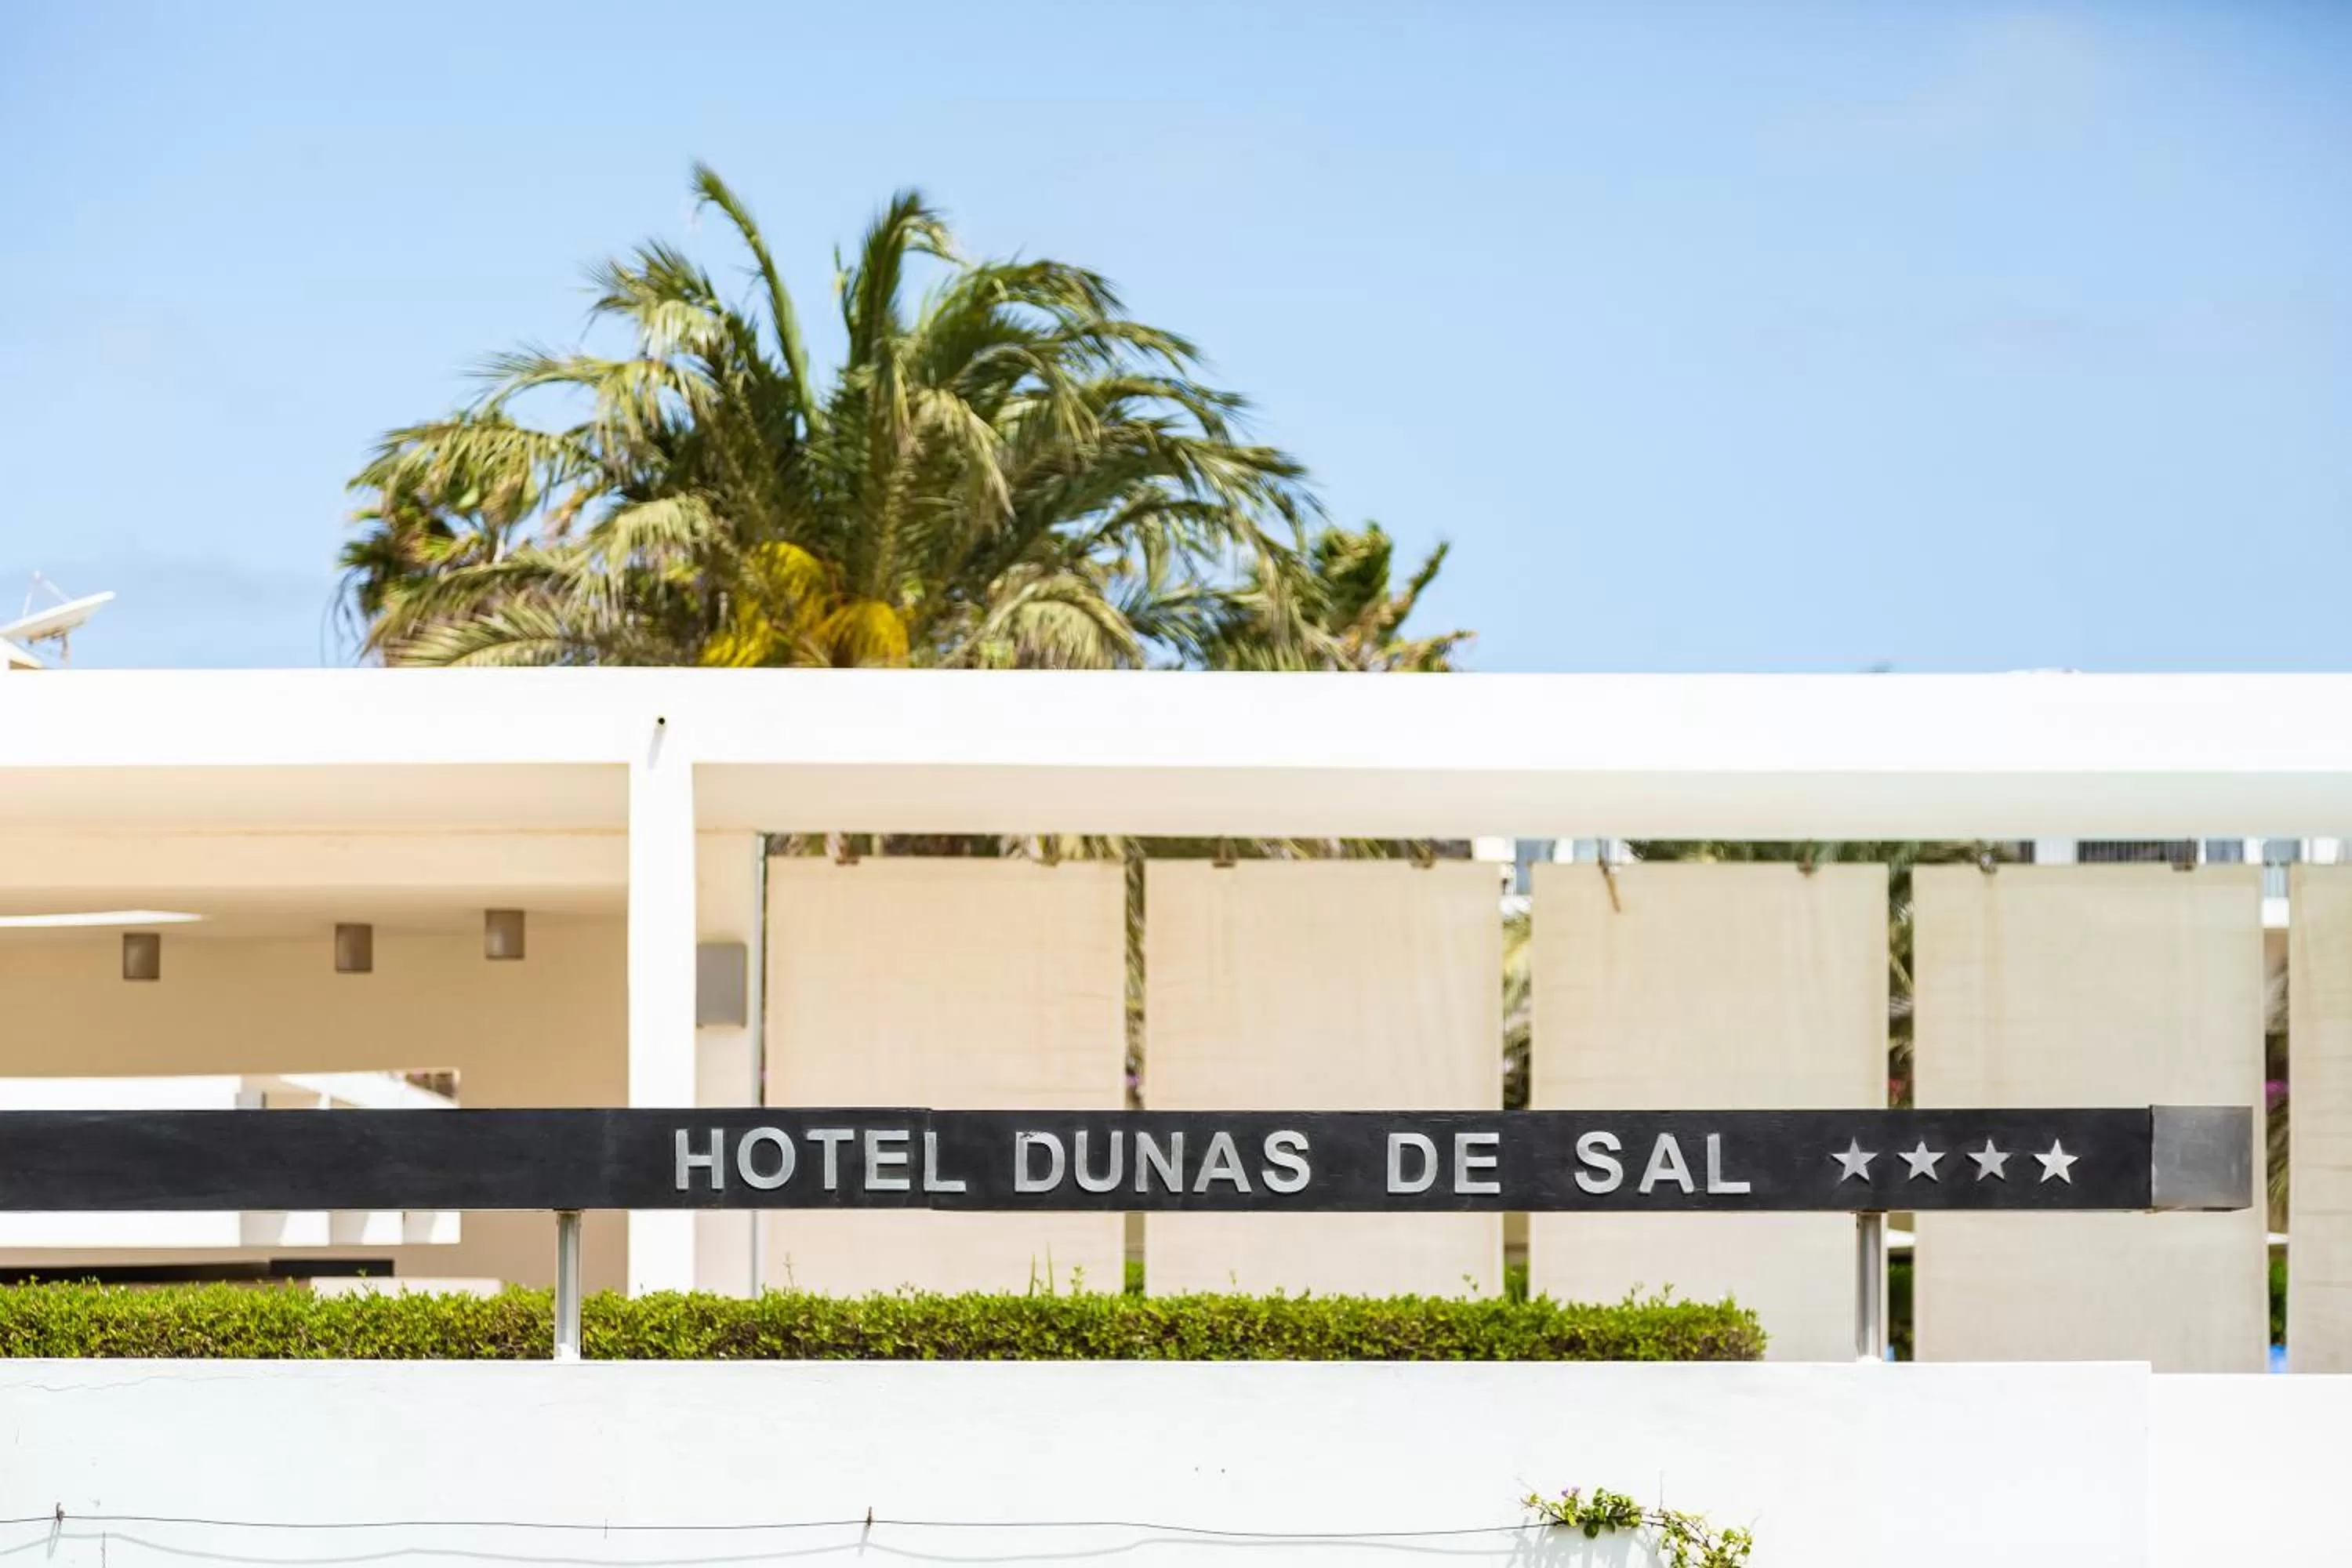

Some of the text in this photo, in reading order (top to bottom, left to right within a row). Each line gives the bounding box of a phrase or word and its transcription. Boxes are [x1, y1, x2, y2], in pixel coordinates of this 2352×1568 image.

[674, 1127, 1751, 1195] HOTEL DUNAS DE SAL
